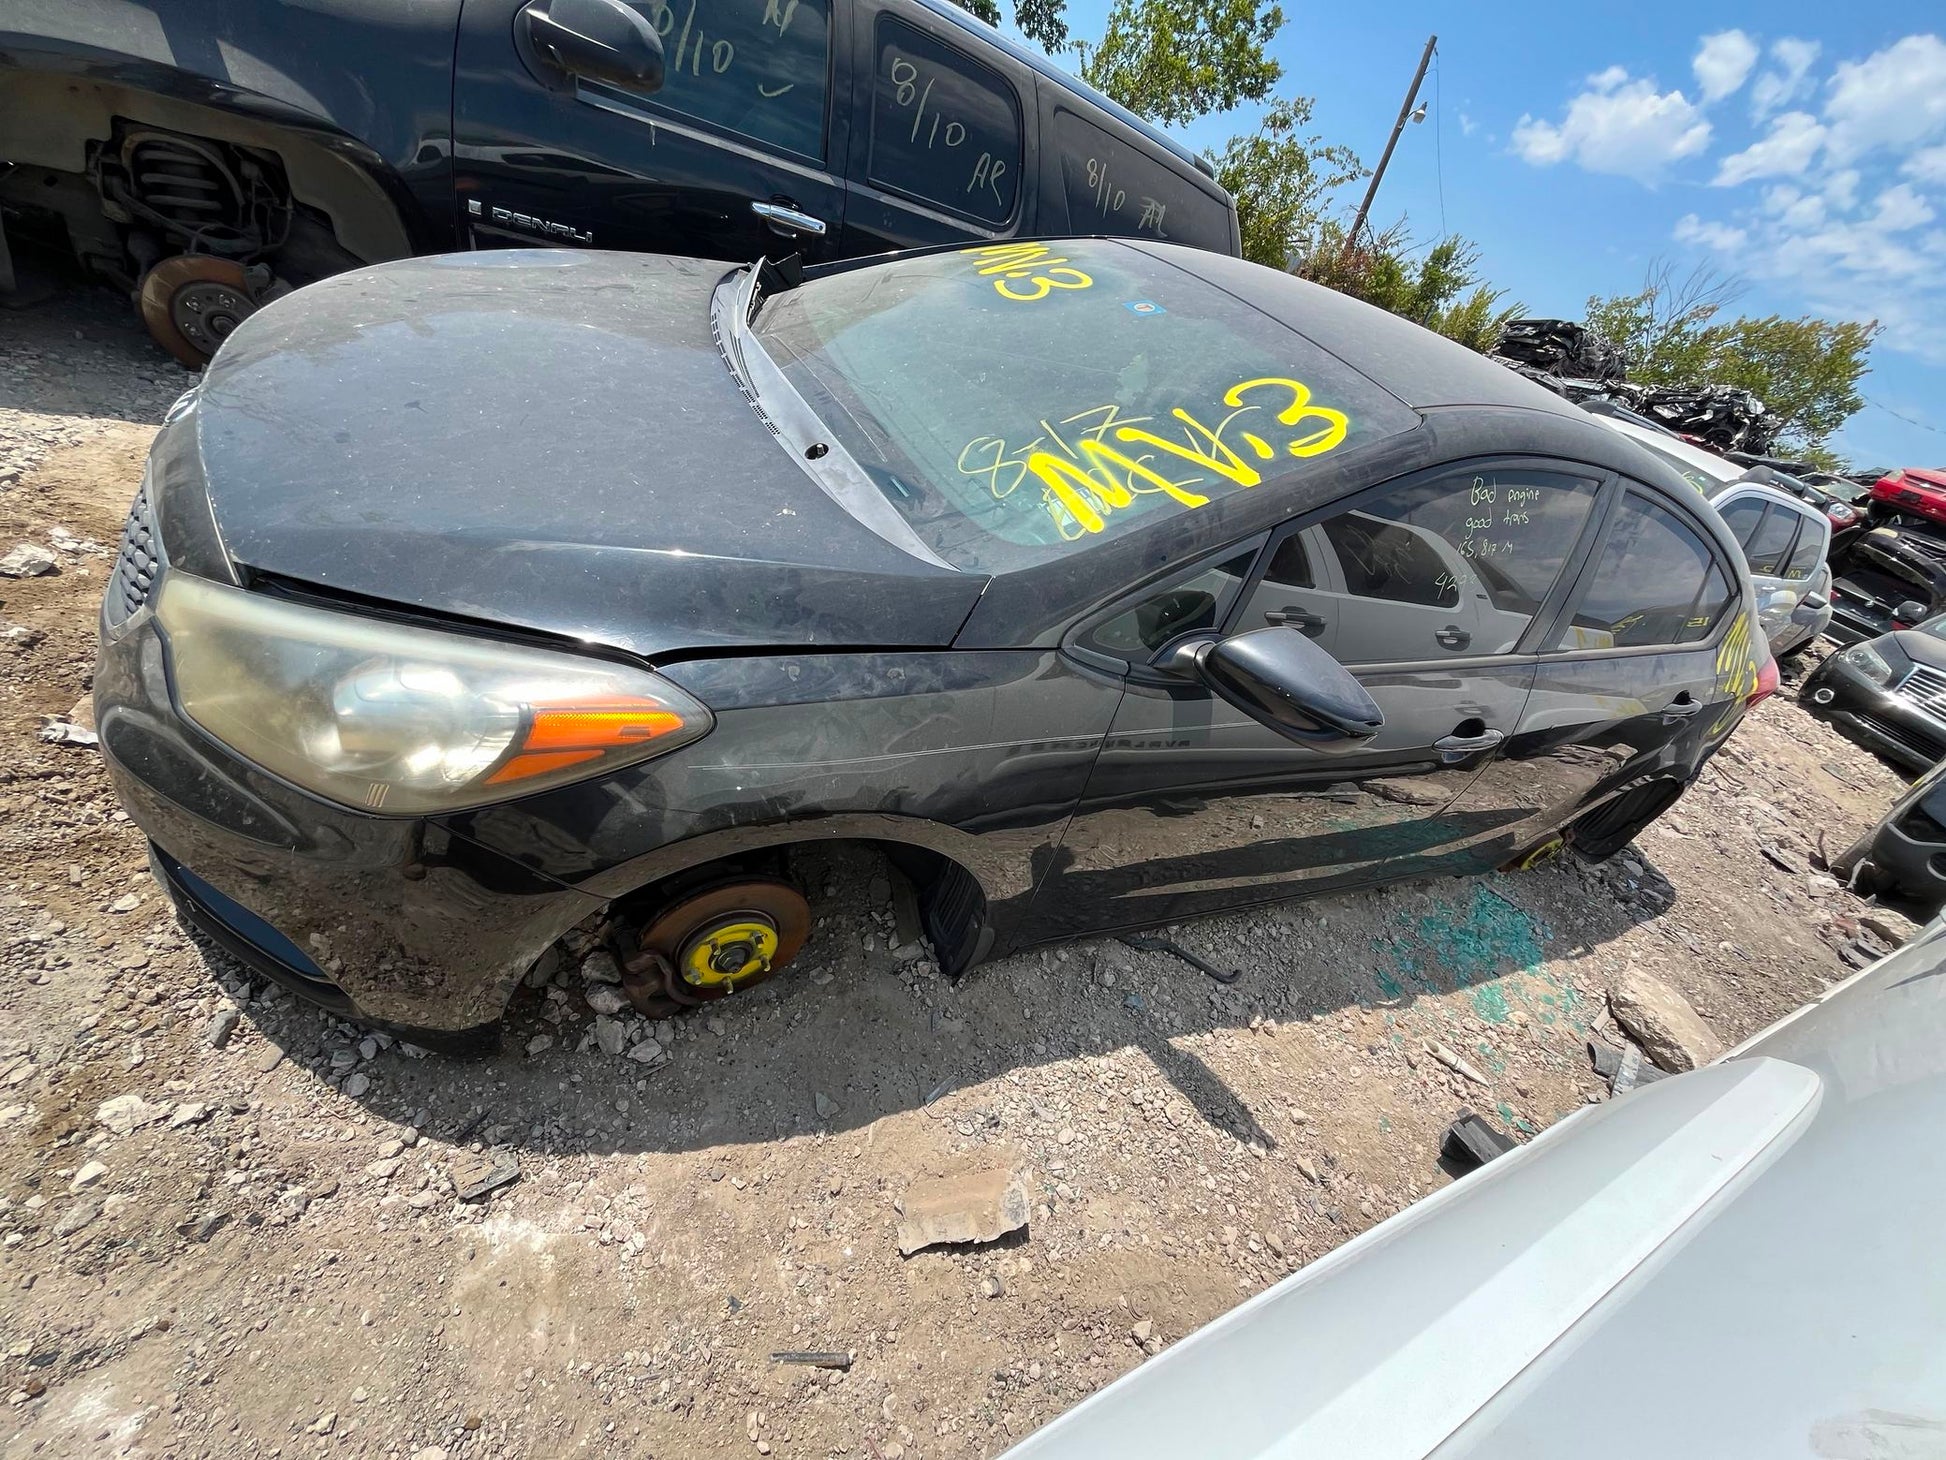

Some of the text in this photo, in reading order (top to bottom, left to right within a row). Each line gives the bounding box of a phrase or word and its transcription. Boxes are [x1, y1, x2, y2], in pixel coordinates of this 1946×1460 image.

[891, 57, 966, 149] 8/10
[1086, 158, 1126, 219] 8/10
[492, 206, 593, 243] DENALI
[1470, 475, 1540, 507] Bad engine
[1465, 506, 1530, 540] good trans
